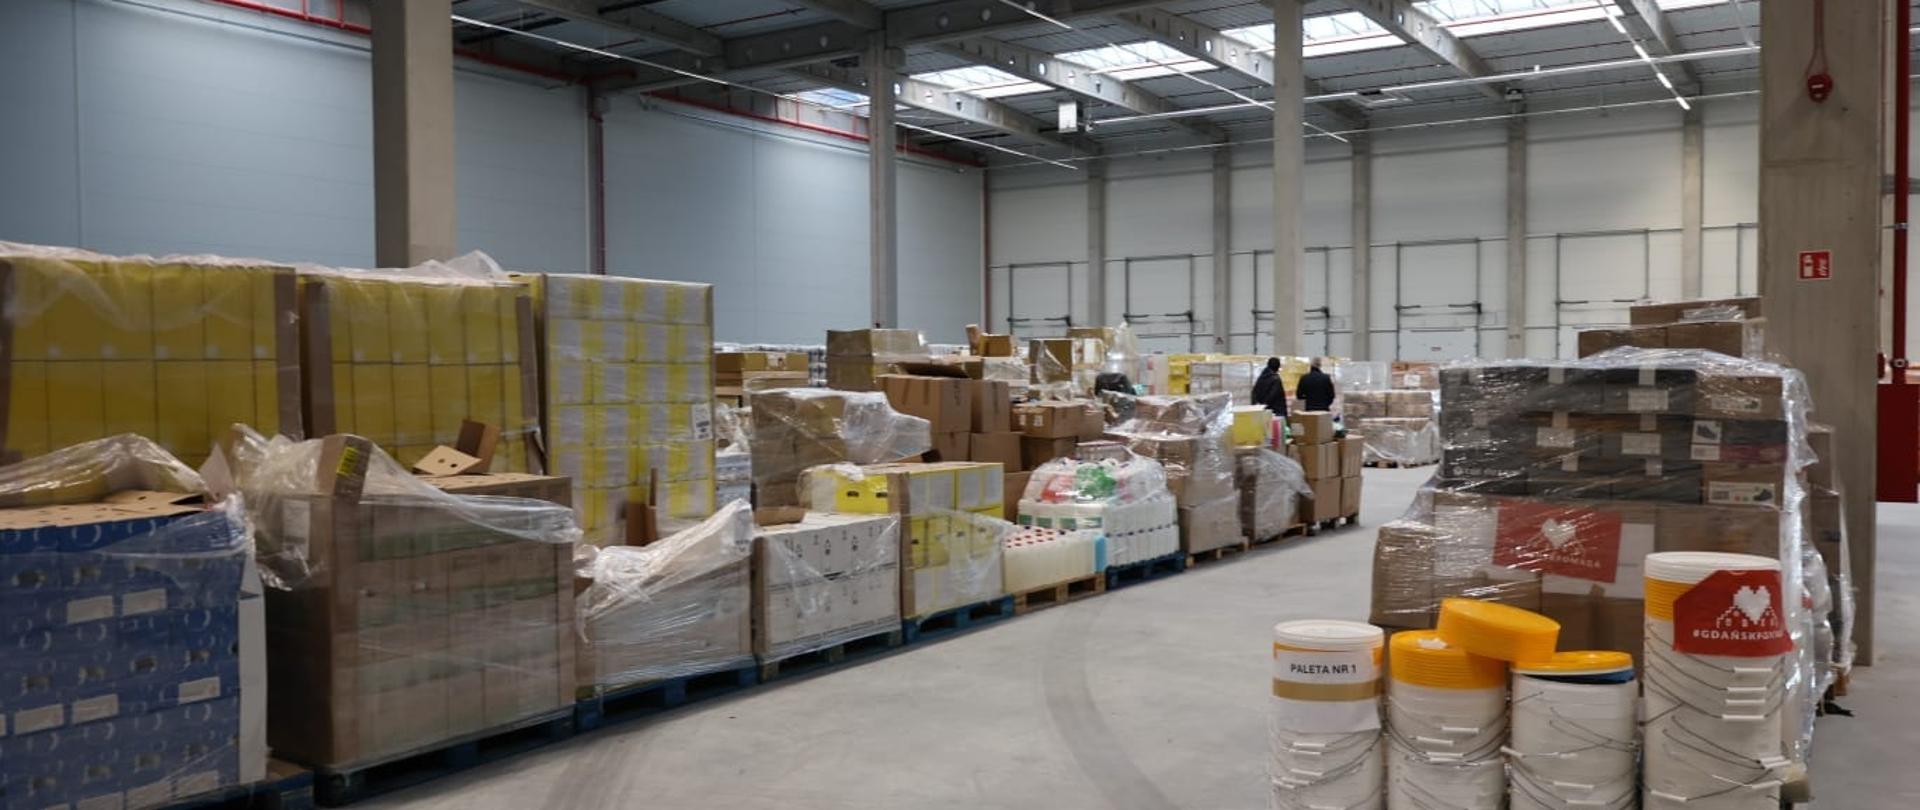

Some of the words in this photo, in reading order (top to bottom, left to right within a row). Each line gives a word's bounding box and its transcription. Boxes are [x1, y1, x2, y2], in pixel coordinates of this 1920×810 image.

[1290, 663, 1331, 674] PALETA
[1332, 664, 1350, 674] NR
[1351, 664, 1357, 674] 1
